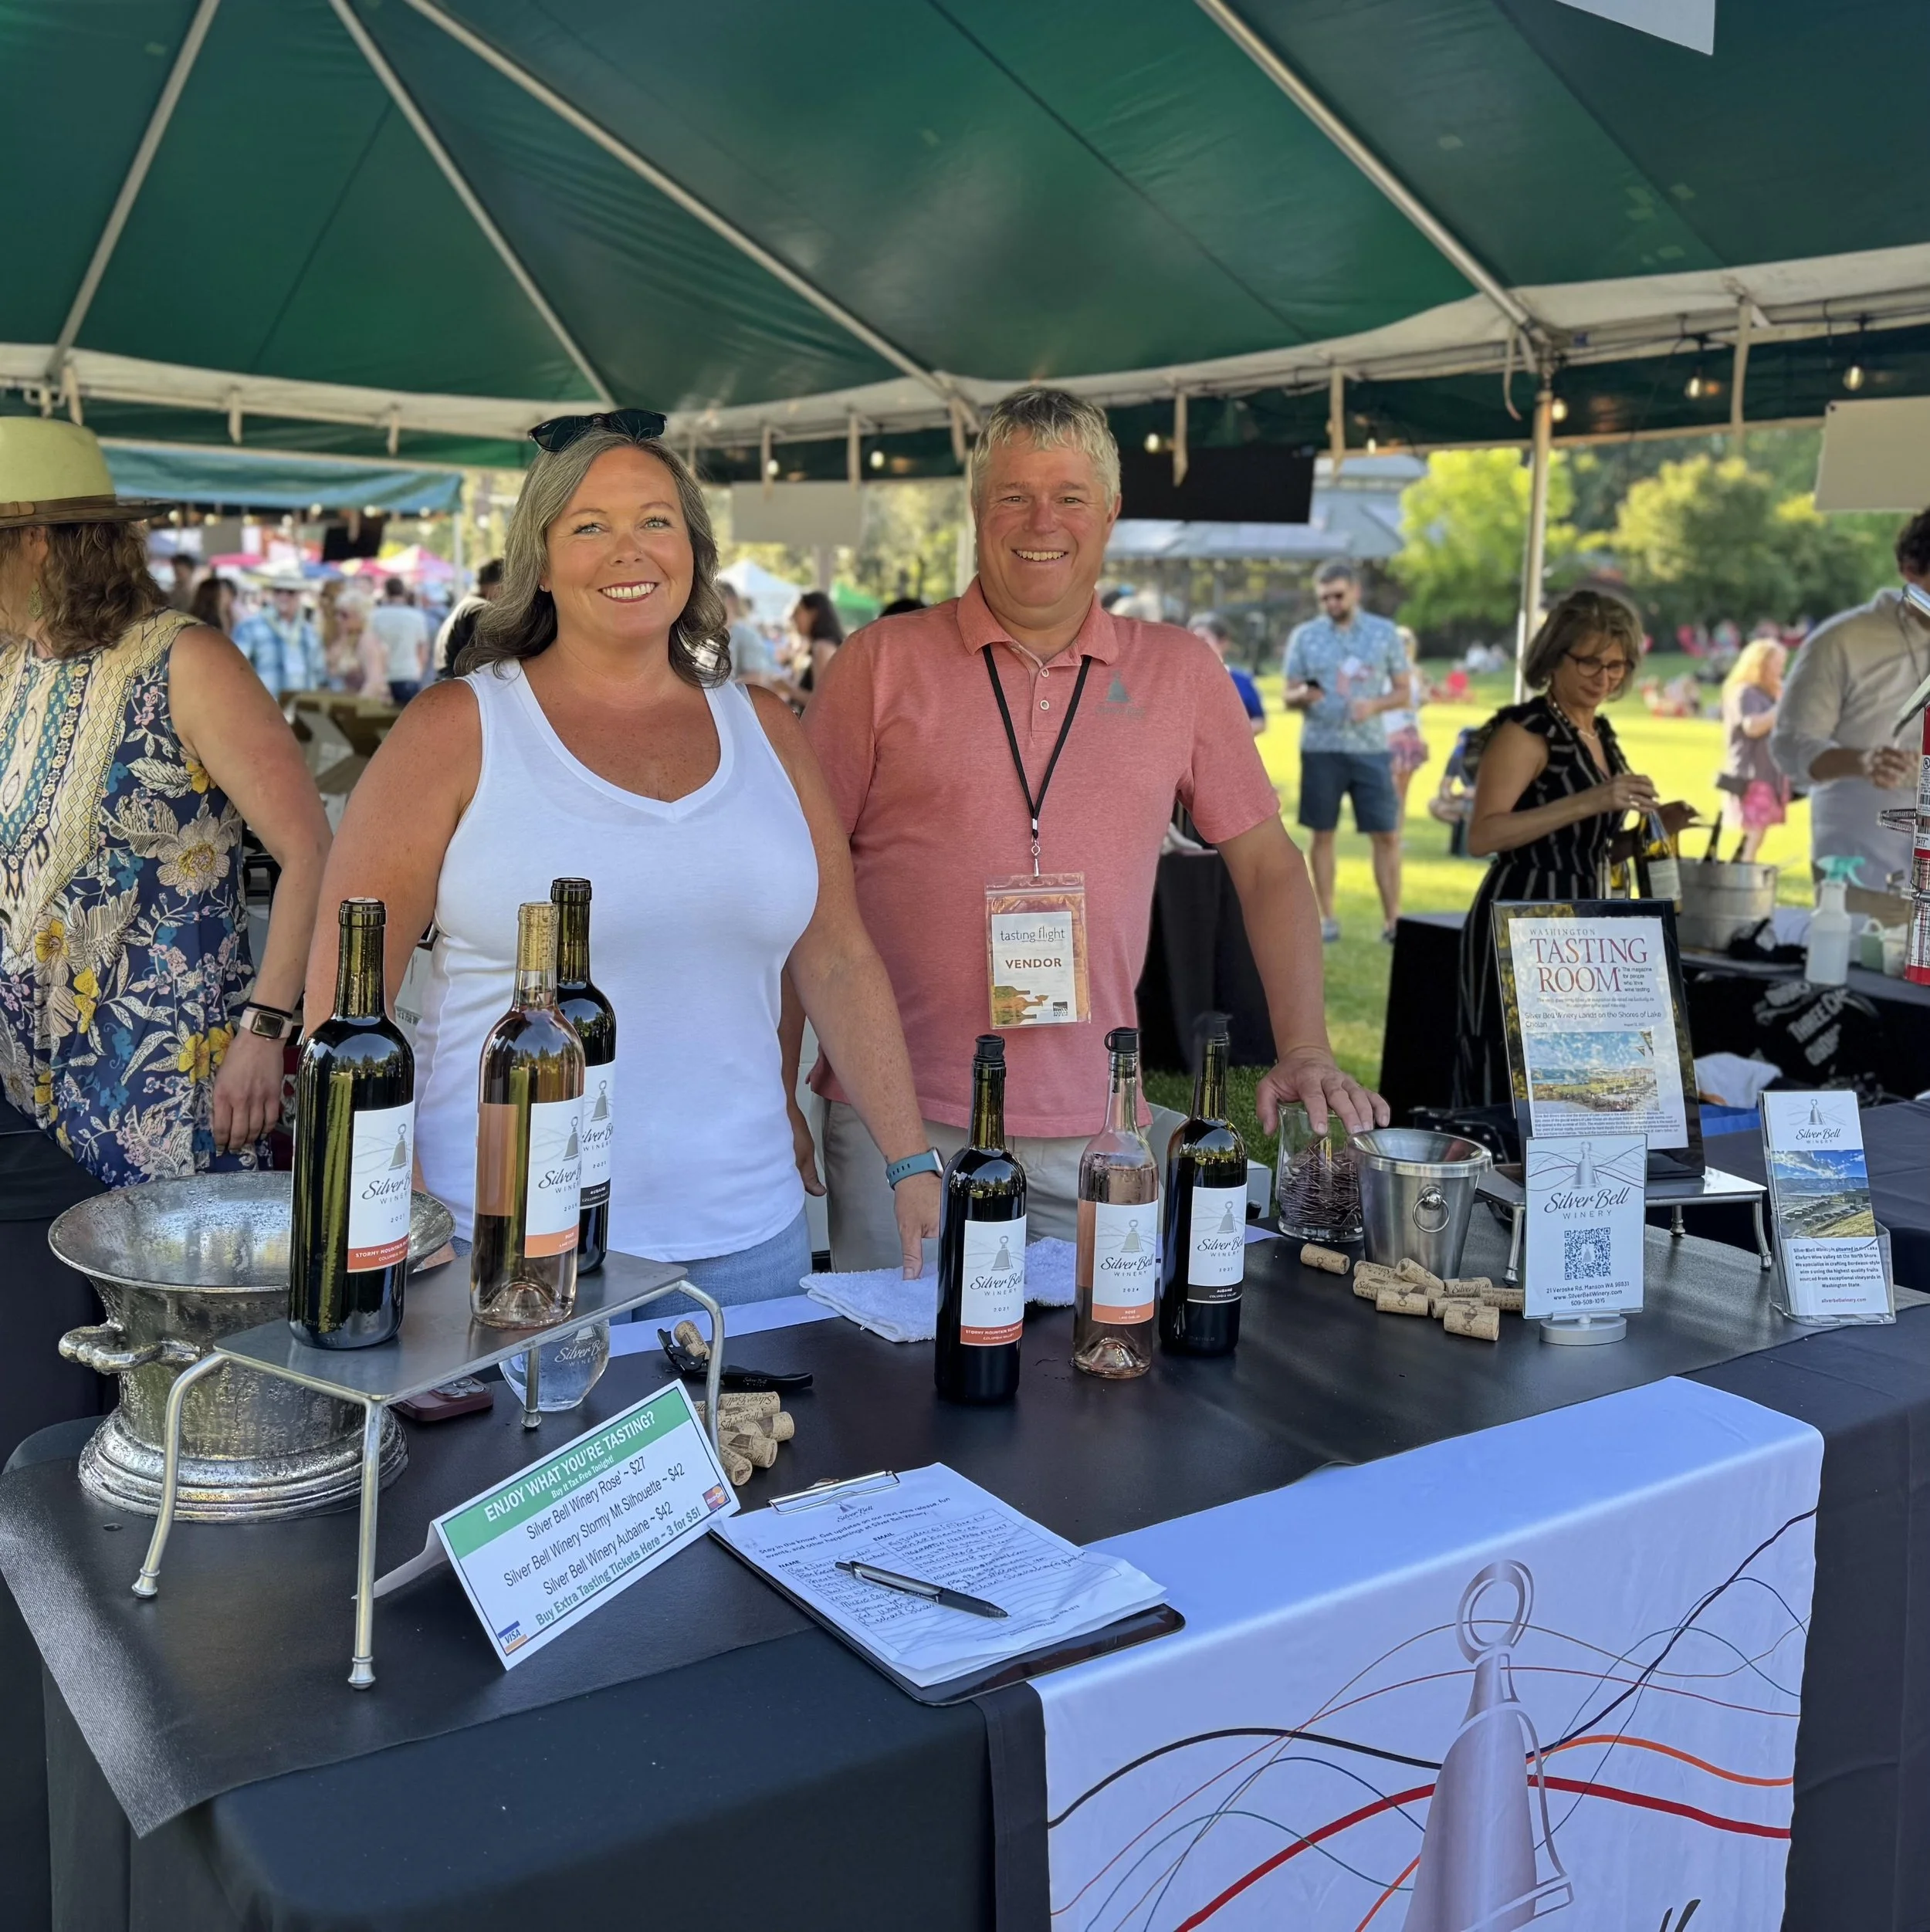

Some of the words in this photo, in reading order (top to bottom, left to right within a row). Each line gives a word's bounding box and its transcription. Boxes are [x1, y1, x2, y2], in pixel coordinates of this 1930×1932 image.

[1001, 930, 1035, 942] tasting
[1038, 926, 1065, 942] flight
[1529, 938, 1647, 964] TASTING
[1005, 958, 1062, 969] VENDOR
[1537, 966, 1622, 993] ROOM
[581, 1128, 604, 1143] ilver
[1796, 1129, 1822, 1140] Silver
[1823, 1128, 1840, 1139] Bell
[538, 1168, 577, 1189] Silver
[362, 1178, 404, 1200] Silver
[1544, 1192, 1594, 1213] Silver
[1595, 1187, 1630, 1210] Bell
[1563, 1210, 1612, 1220] WINERY
[1197, 1239, 1231, 1251] Silver
[1101, 1257, 1136, 1271] Silver
[970, 1276, 1007, 1290] Silver
[1451, 1284, 1473, 1294] Silver
[555, 1345, 591, 1363] Silver
[483, 1487, 526, 1522] ENJOY
[525, 1466, 562, 1497] WHAT
[560, 1441, 604, 1473] YOU'RE
[603, 1411, 655, 1450] TASTING?
[551, 1487, 564, 1500] Buy
[567, 1477, 580, 1488] Tax
[577, 1470, 592, 1483] Free
[591, 1455, 615, 1475] Tonight!
[527, 1511, 554, 1539] Silver
[552, 1501, 571, 1524] Bell
[569, 1487, 600, 1517] Winery
[628, 1456, 646, 1476] $27
[503, 1561, 531, 1587] Silver
[530, 1548, 552, 1572] Bell
[549, 1531, 581, 1563] Winery
[579, 1511, 611, 1540] Stormy
[609, 1501, 624, 1521] Mt
[621, 1478, 662, 1511] Silhouette
[667, 1463, 686, 1483] $42
[834, 1523, 861, 1534] updates
[824, 1528, 864, 1542] happenings
[872, 1532, 895, 1541] EMAIL
[543, 1570, 568, 1596] Silver
[569, 1557, 589, 1579] Bell
[587, 1541, 618, 1572] Winery
[616, 1521, 650, 1550] Aubaine
[655, 1501, 673, 1523] $42
[535, 1609, 554, 1626] Buy
[553, 1593, 580, 1614] Extra
[577, 1570, 611, 1598] Tasting
[608, 1550, 641, 1577] Tickets
[639, 1535, 660, 1555] Here
[666, 1525, 674, 1537] 3
[673, 1517, 687, 1533] for
[685, 1506, 701, 1524] $5!
[504, 1629, 521, 1644] VISA
